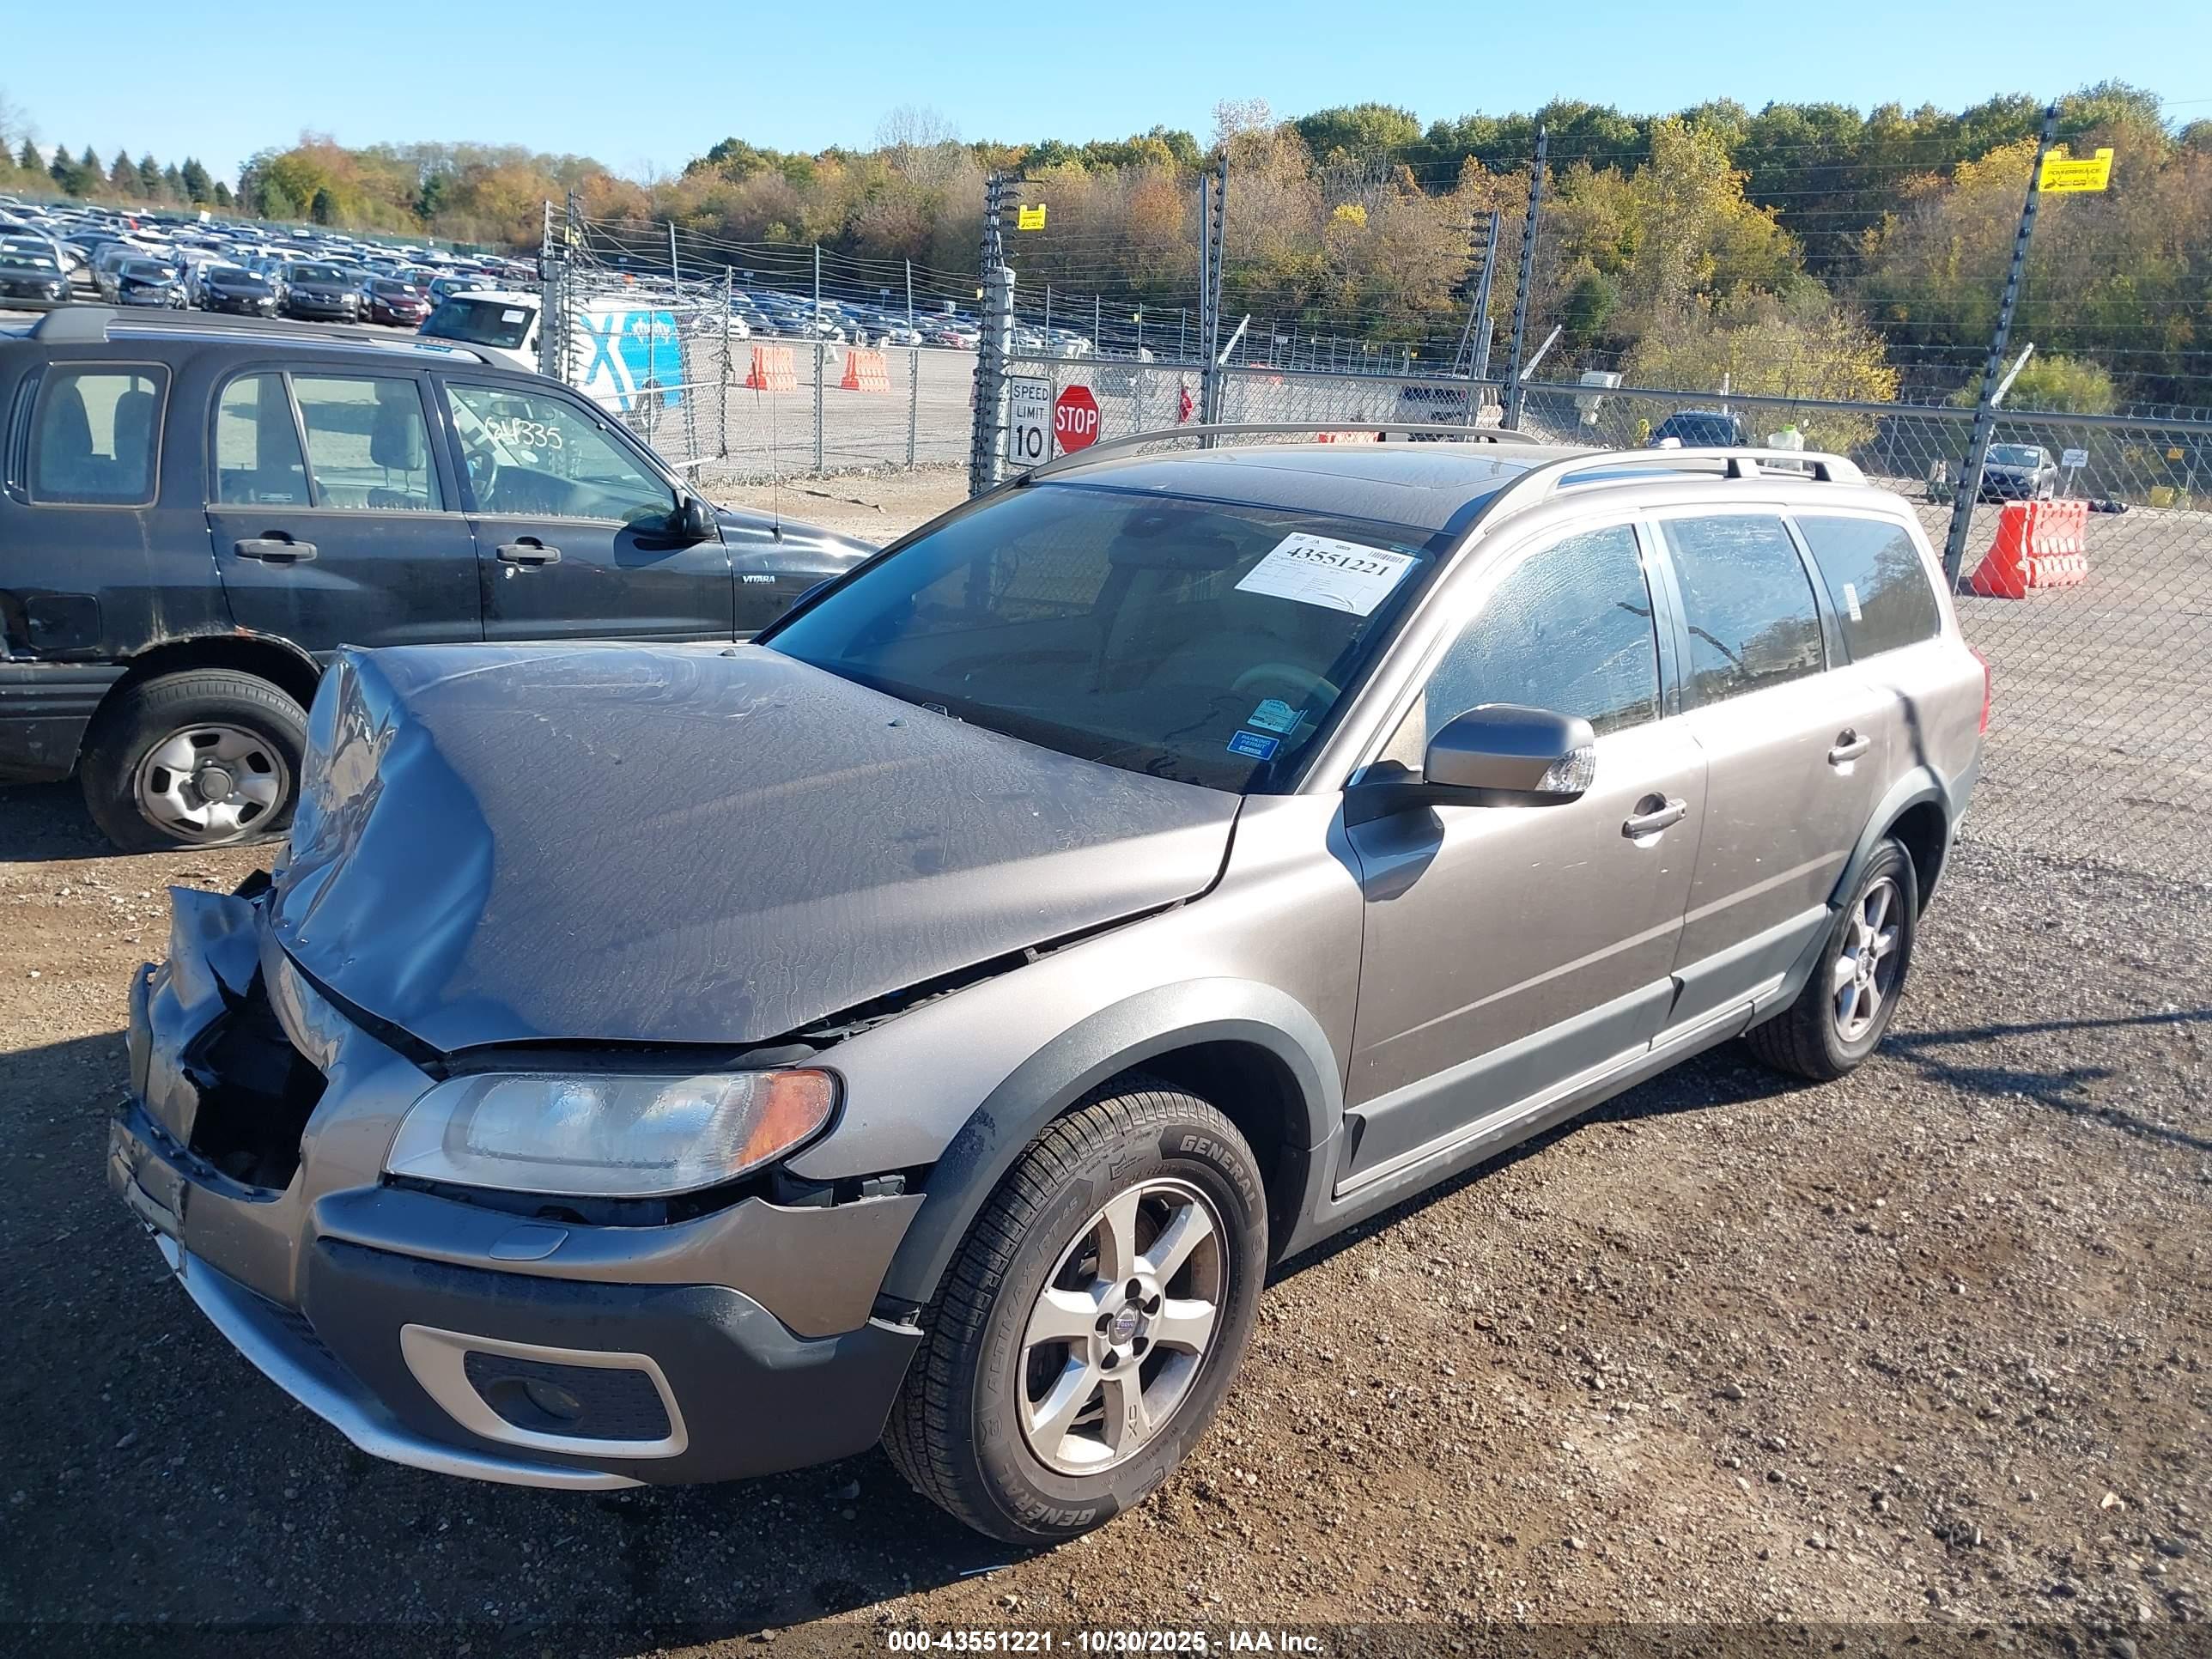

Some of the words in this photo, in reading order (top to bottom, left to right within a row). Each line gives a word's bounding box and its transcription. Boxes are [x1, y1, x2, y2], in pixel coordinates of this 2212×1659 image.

[1013, 386, 1048, 401] SPEED
[1017, 405, 1045, 420] LIMIT
[1056, 405, 1097, 434] STOP
[1017, 425, 1043, 459] 10
[1286, 546, 1389, 576] 43551221
[742, 574, 775, 583] VITARA
[1241, 734, 1271, 745] PARKING
[1241, 739, 1267, 750] PERMIT
[1179, 1134, 1258, 1212] GENERAL
[996, 1462, 1097, 1527] GENERAL
